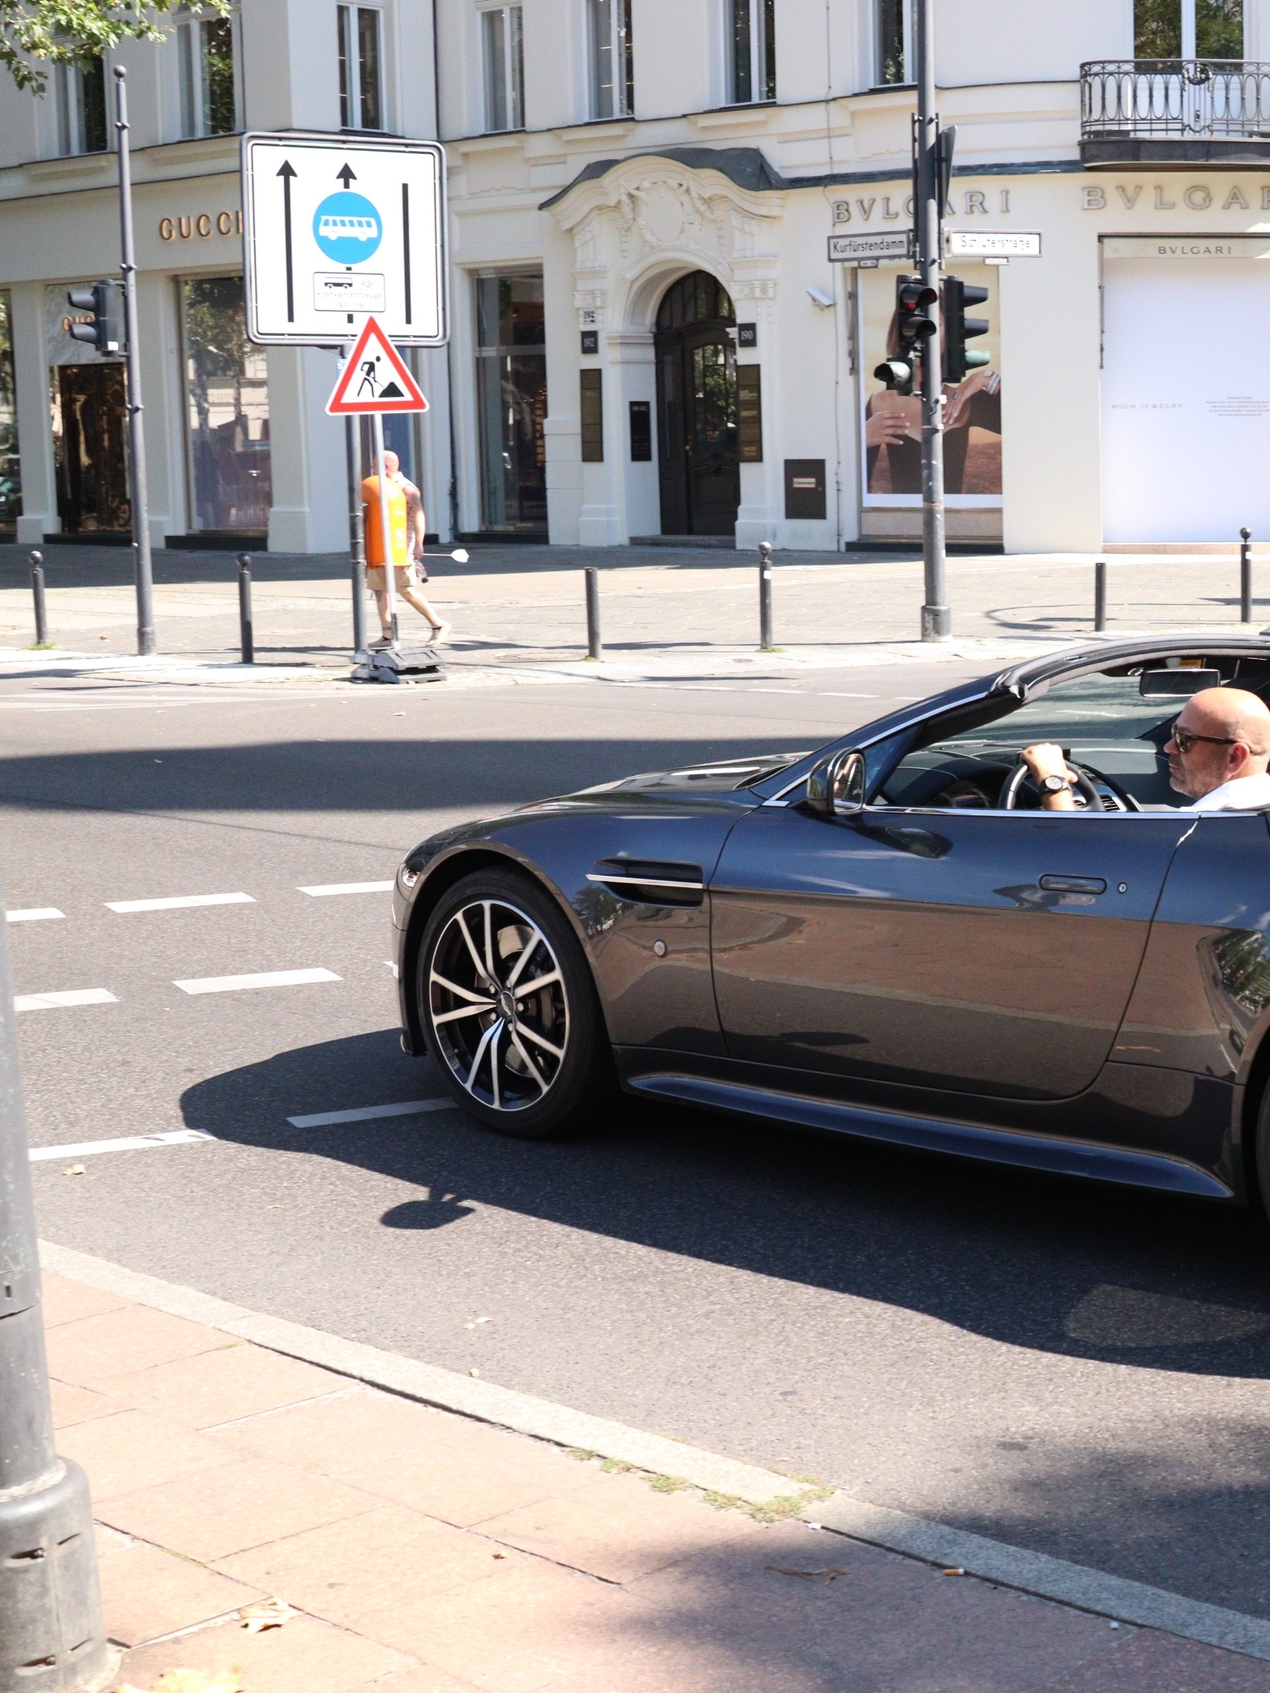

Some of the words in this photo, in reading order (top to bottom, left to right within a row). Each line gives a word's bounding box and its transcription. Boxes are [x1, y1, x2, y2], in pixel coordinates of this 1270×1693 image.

[159, 210, 243, 241] GUCCI
[833, 239, 905, 253] Kurfürstendamm
[1158, 246, 1232, 255] BVLGARI
